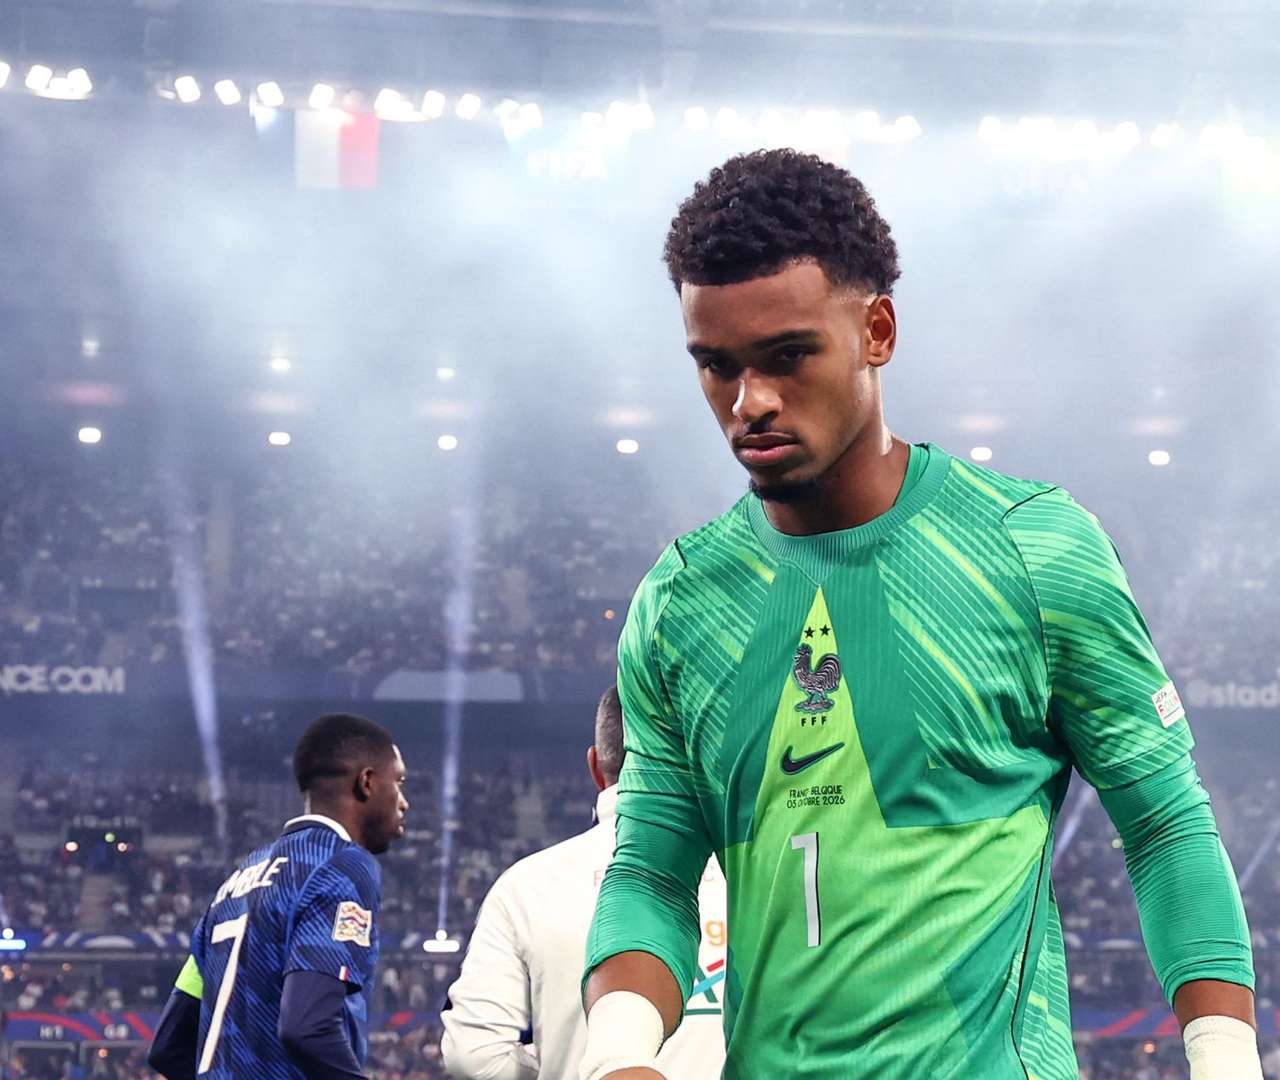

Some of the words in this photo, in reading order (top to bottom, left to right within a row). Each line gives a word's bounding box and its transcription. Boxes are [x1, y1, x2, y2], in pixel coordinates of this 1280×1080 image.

[822, 795, 845, 805] 2026
[791, 832, 821, 947] 1
[198, 913, 248, 1074] 7
